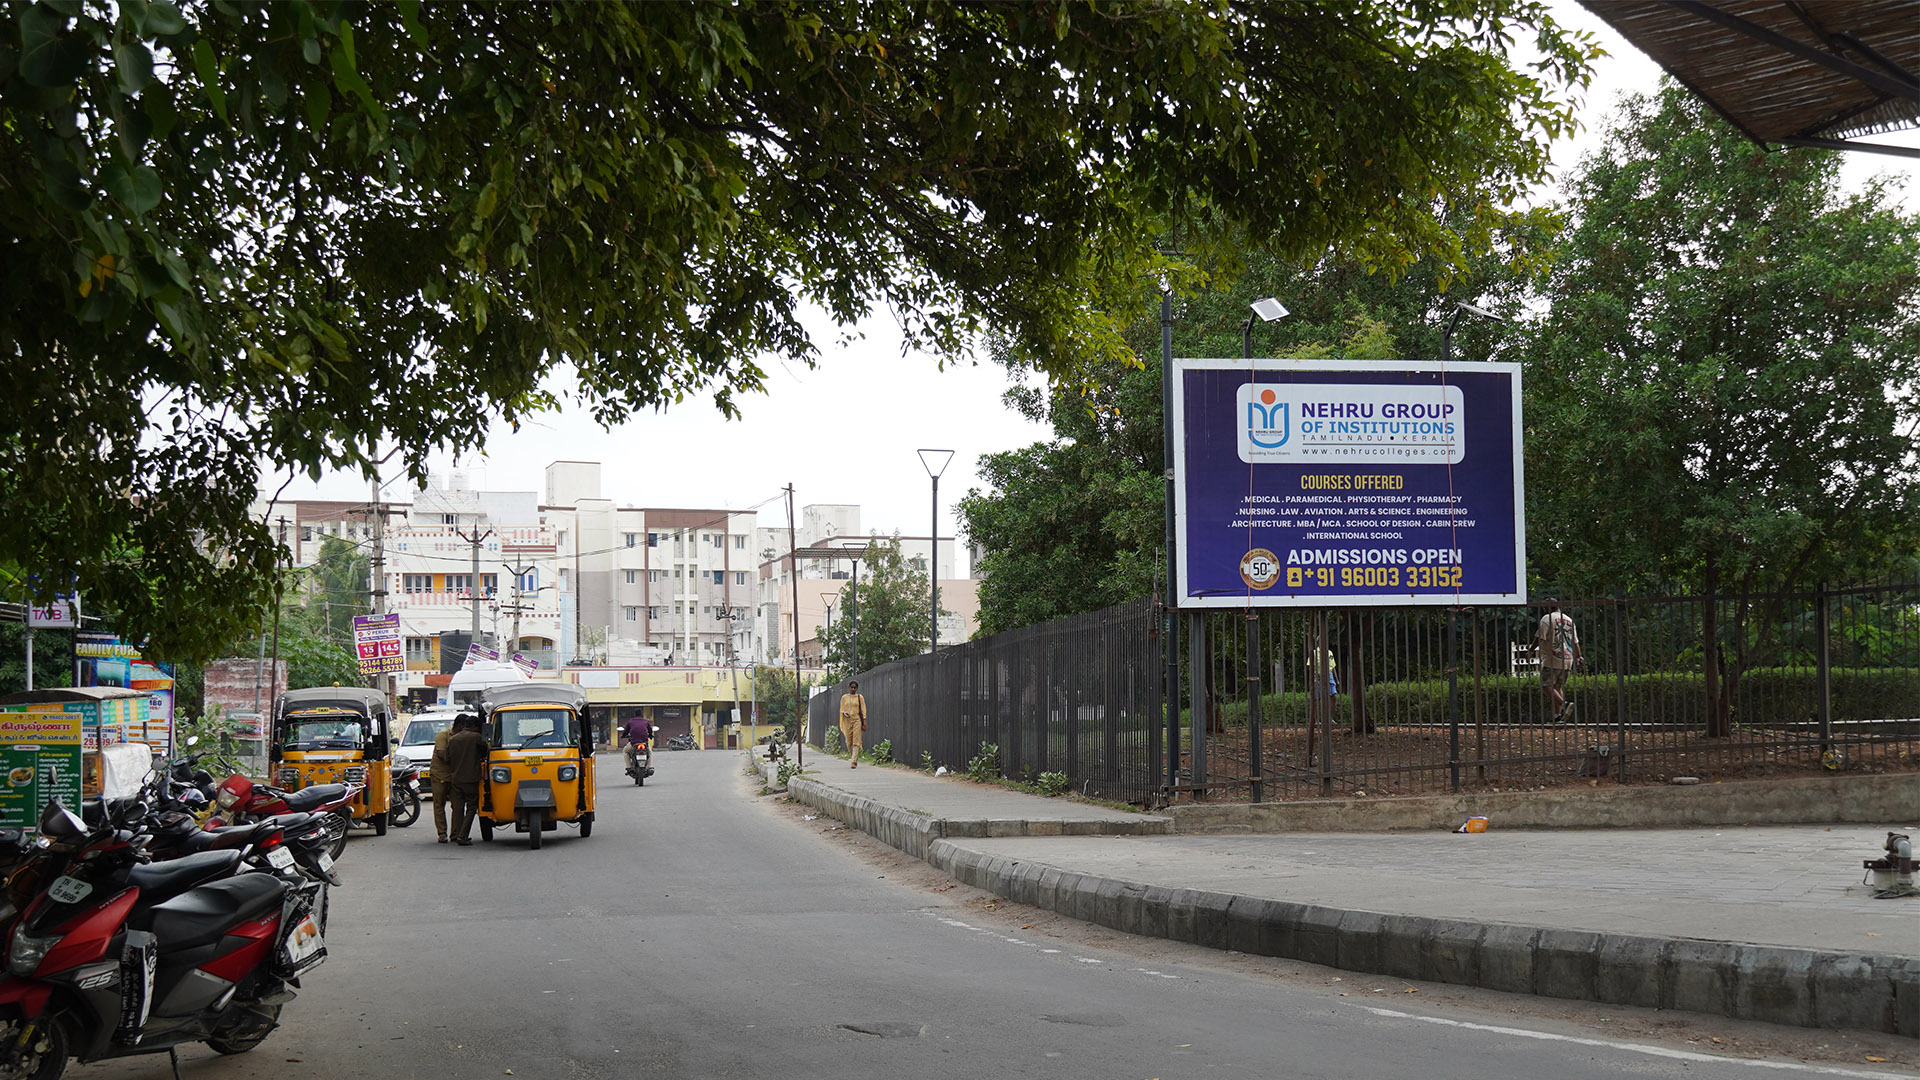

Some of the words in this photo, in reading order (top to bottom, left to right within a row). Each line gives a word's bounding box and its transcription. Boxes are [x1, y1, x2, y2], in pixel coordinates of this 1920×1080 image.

[1302, 402, 1374, 418] NEHRU
[1381, 403, 1454, 419] GROUP
[1301, 421, 1323, 434] OF
[1329, 421, 1455, 434] INSTITUTIONS
[1402, 434, 1455, 442] KERALA
[1302, 447, 1456, 457] www.nehrucolleges.com
[1301, 475, 1351, 490] COURSES
[1354, 475, 1403, 490] OFFERED
[1286, 549, 1408, 564] ADMISSIONS
[1411, 549, 1462, 564] OPEN
[1304, 567, 1335, 587] +91
[1341, 567, 1400, 587] 96003
[1406, 566, 1463, 588] 33152
[76, 643, 113, 657] FAMILY
[364, 646, 374, 654] 15
[382, 644, 398, 652] 14.5
[382, 657, 402, 666] 84789
[360, 666, 381, 674] 96266
[382, 664, 404, 672] 55733
[80, 971, 114, 989] 125
